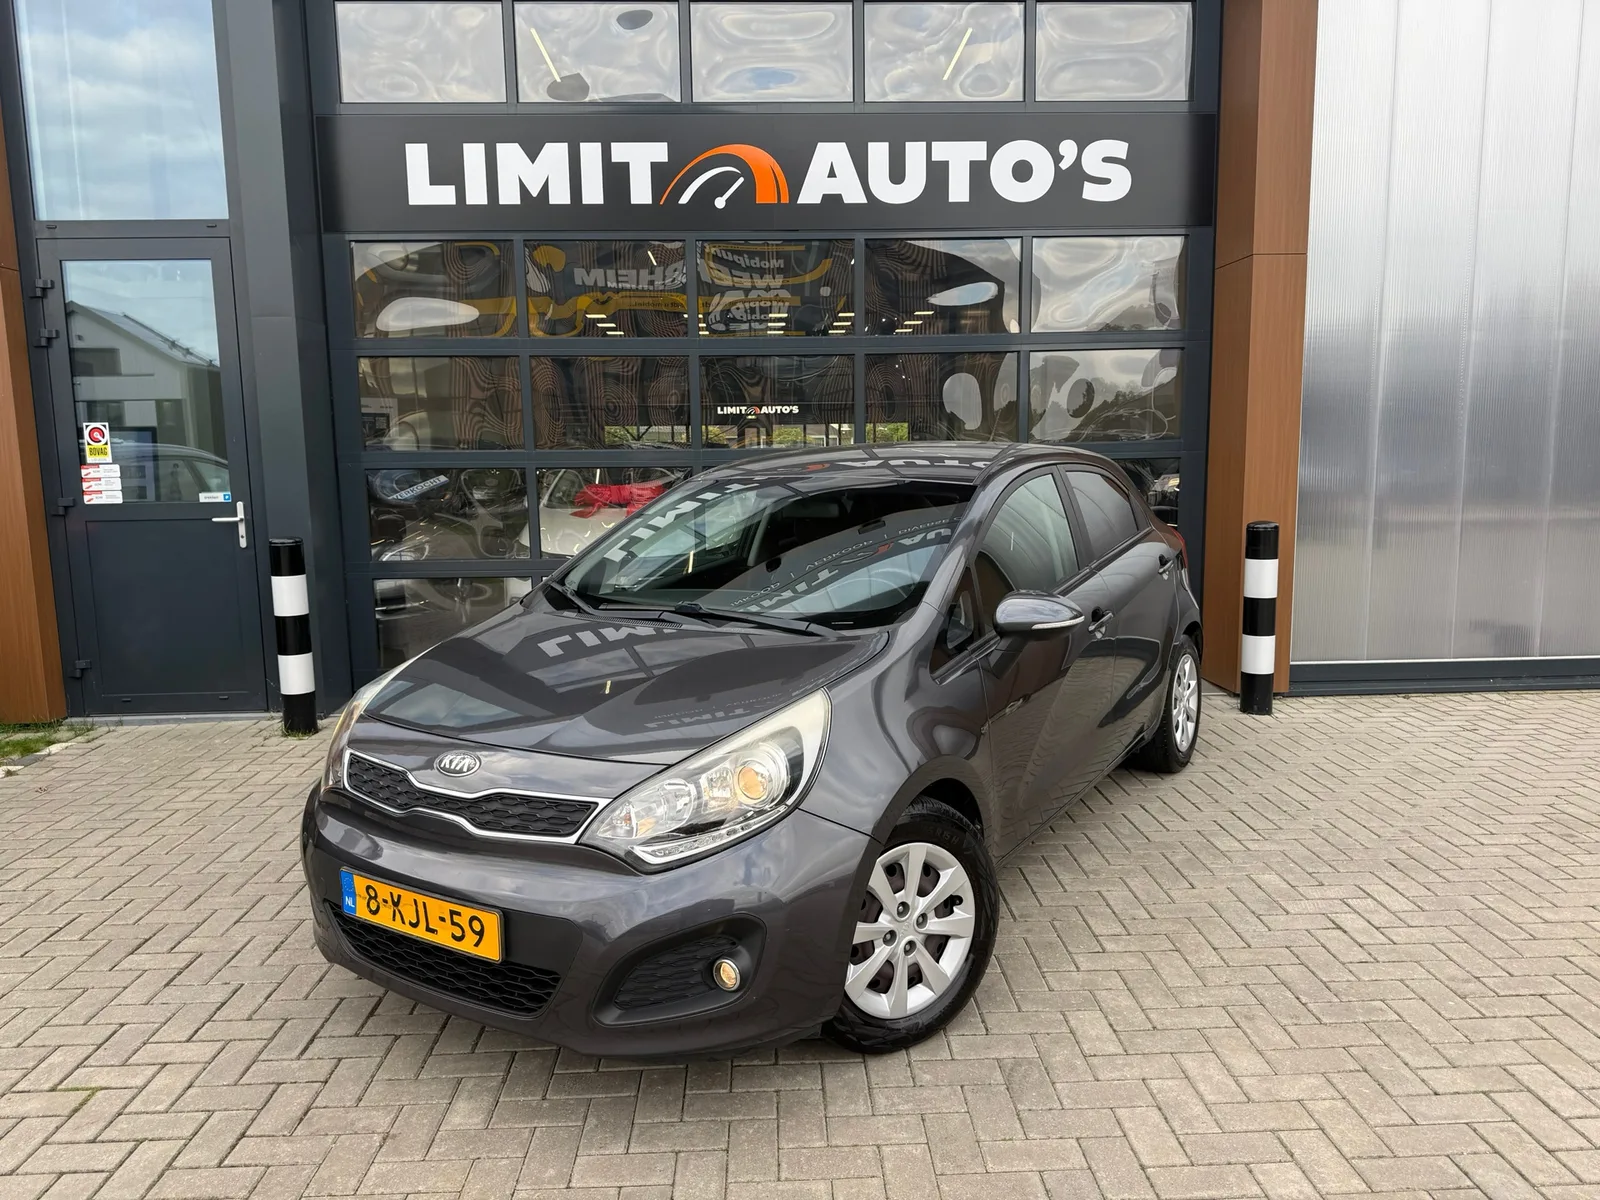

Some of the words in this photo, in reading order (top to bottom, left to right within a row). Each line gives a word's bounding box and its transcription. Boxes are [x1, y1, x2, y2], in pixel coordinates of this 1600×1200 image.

[405, 142, 668, 206] LIMIT
[797, 139, 1132, 205] AUTO'S
[717, 406, 748, 415] LIMIT
[760, 405, 800, 414] AUTO'S
[89, 447, 108, 456] BOVAG
[393, 477, 443, 500] VERKOCHT
[440, 755, 471, 773] KIA
[345, 895, 356, 909] NL
[364, 883, 486, 948] 8-KJL-59
